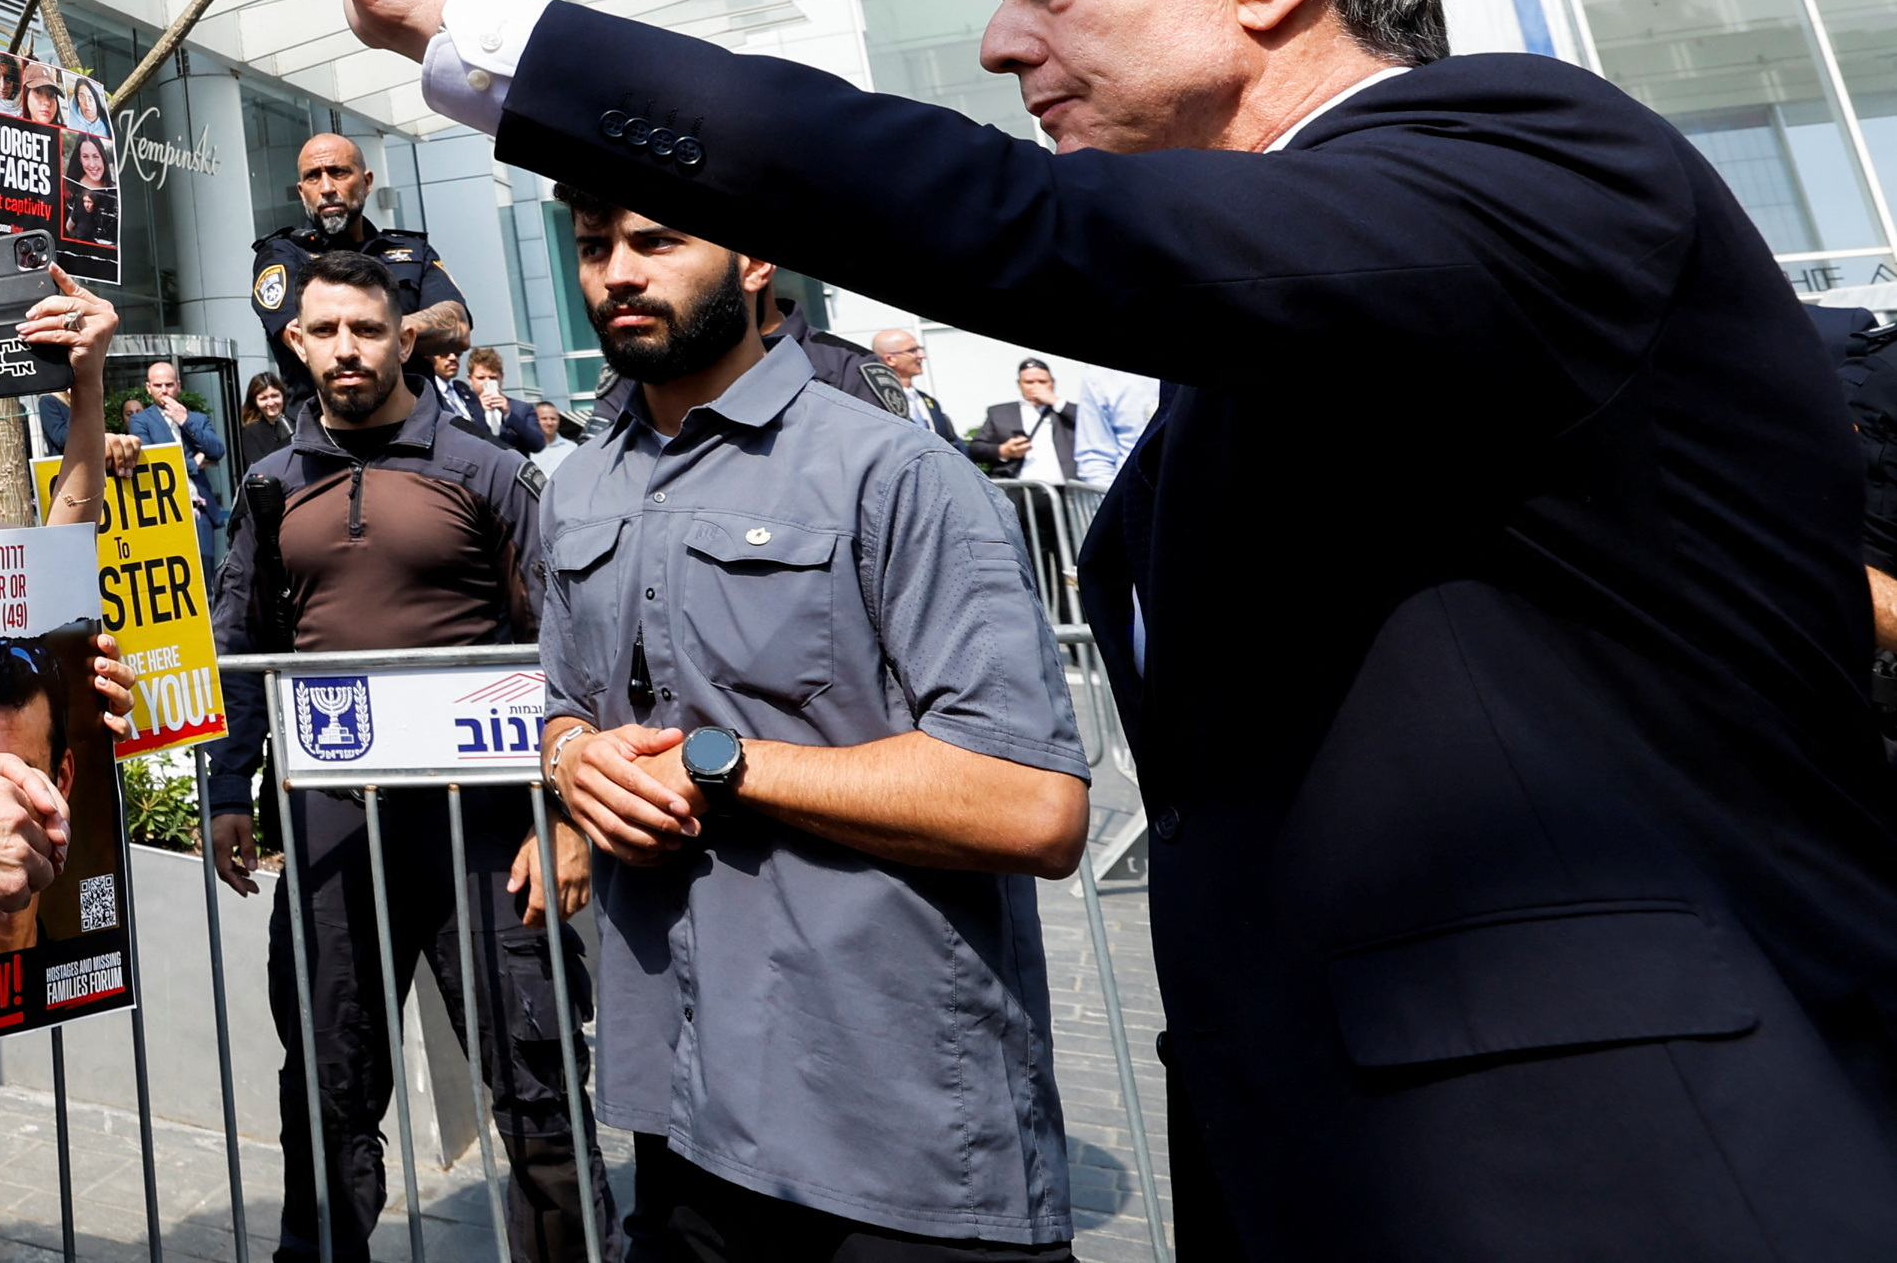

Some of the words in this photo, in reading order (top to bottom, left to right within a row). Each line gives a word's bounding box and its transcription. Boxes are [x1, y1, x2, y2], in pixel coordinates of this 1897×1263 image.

[118, 106, 222, 191] Kempinski
[5, 197, 52, 221] captivity
[114, 537, 130, 559] To
[10, 574, 27, 598] OR
[2, 601, 28, 632] (49)
[147, 645, 181, 671] HERE
[140, 666, 217, 736] YOU!
[46, 960, 79, 983] HOSTAGES
[79, 957, 92, 975] AND
[93, 950, 122, 972] MISSING
[47, 976, 88, 1005] FAMILIES
[90, 966, 124, 995] FORUM
